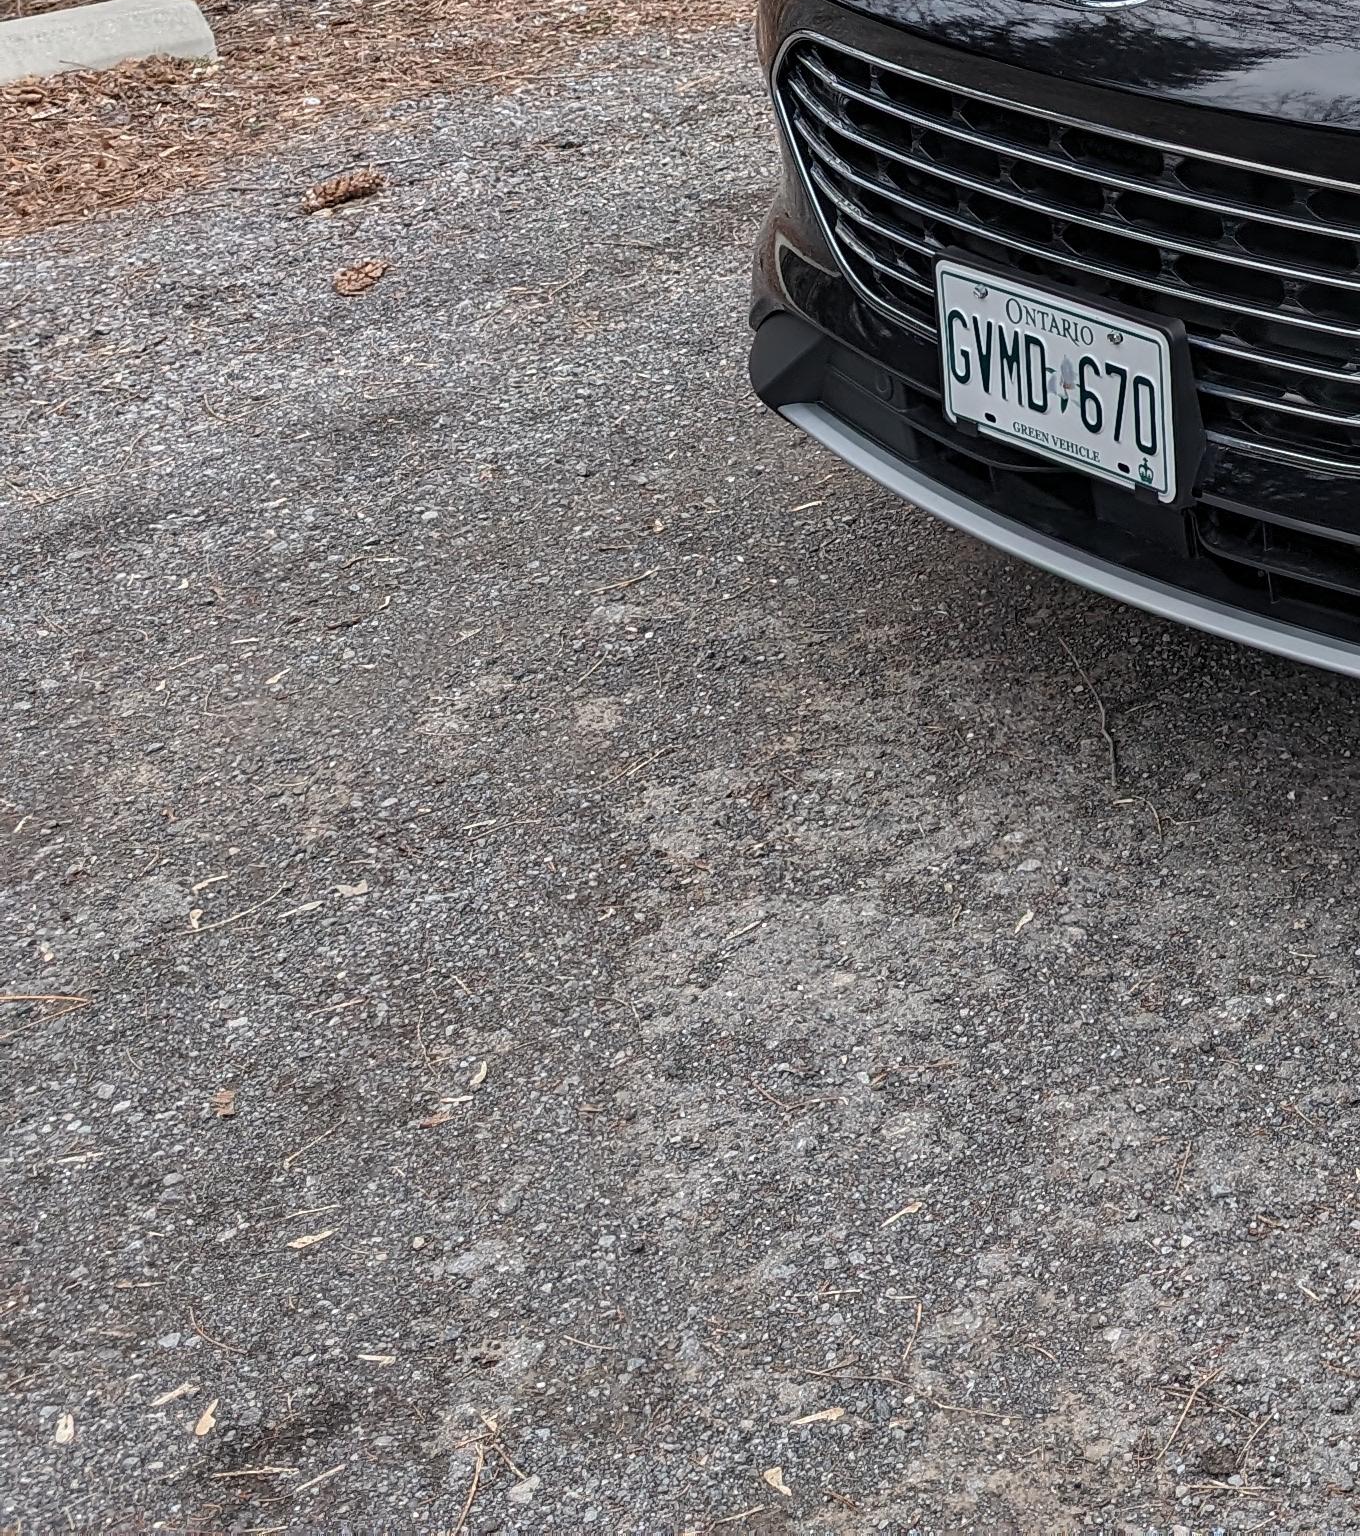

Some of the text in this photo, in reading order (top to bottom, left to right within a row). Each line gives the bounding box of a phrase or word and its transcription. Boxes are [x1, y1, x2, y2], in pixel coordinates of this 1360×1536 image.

[1005, 298, 1094, 347] ONTARIO
[947, 309, 1157, 457] GVMD 670
[1012, 420, 1101, 463] GREEN VEHICLE
